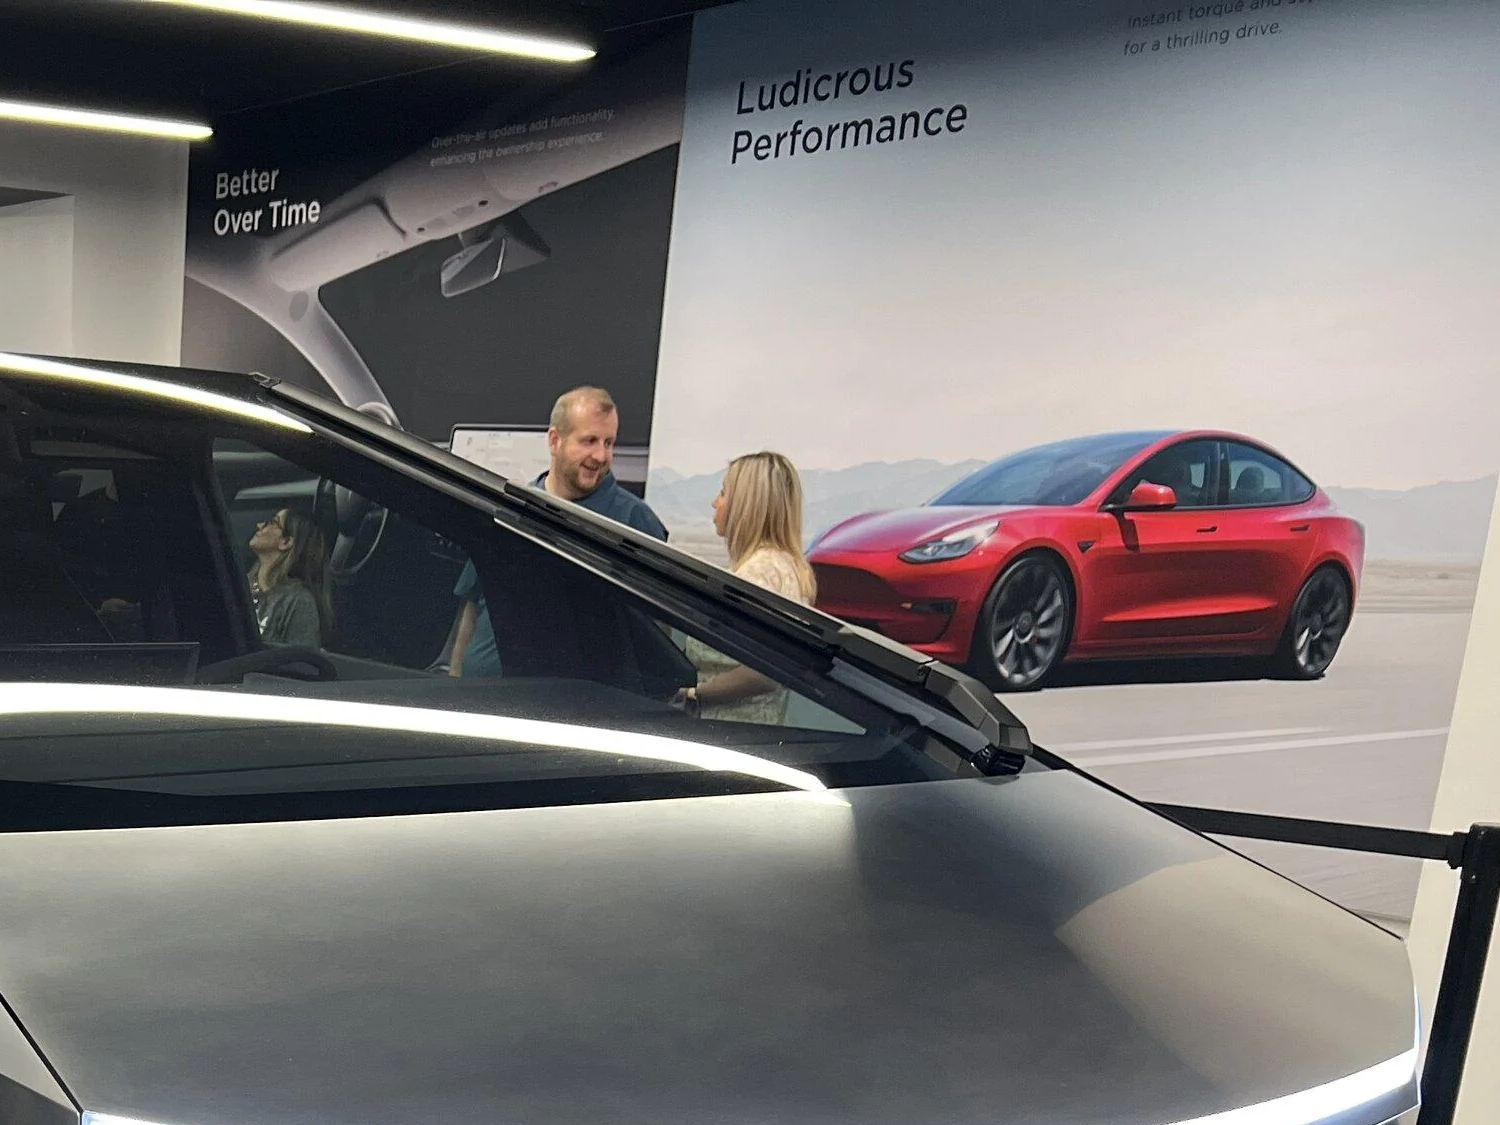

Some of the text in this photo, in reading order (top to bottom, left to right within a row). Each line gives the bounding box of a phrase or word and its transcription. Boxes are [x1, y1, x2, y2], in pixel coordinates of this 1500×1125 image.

[1127, 9, 1182, 28] Instant
[1189, 0, 1244, 20] torque
[1123, 39, 1148, 55] for
[1151, 40, 1161, 51] a
[1166, 28, 1230, 49] thrilling
[736, 58, 916, 115] Ludicrous
[488, 123, 528, 142] updates
[529, 117, 548, 133] add
[731, 103, 968, 165] Performance
[478, 148, 494, 161] the
[215, 167, 280, 200] Better
[214, 198, 321, 236] Over Time
